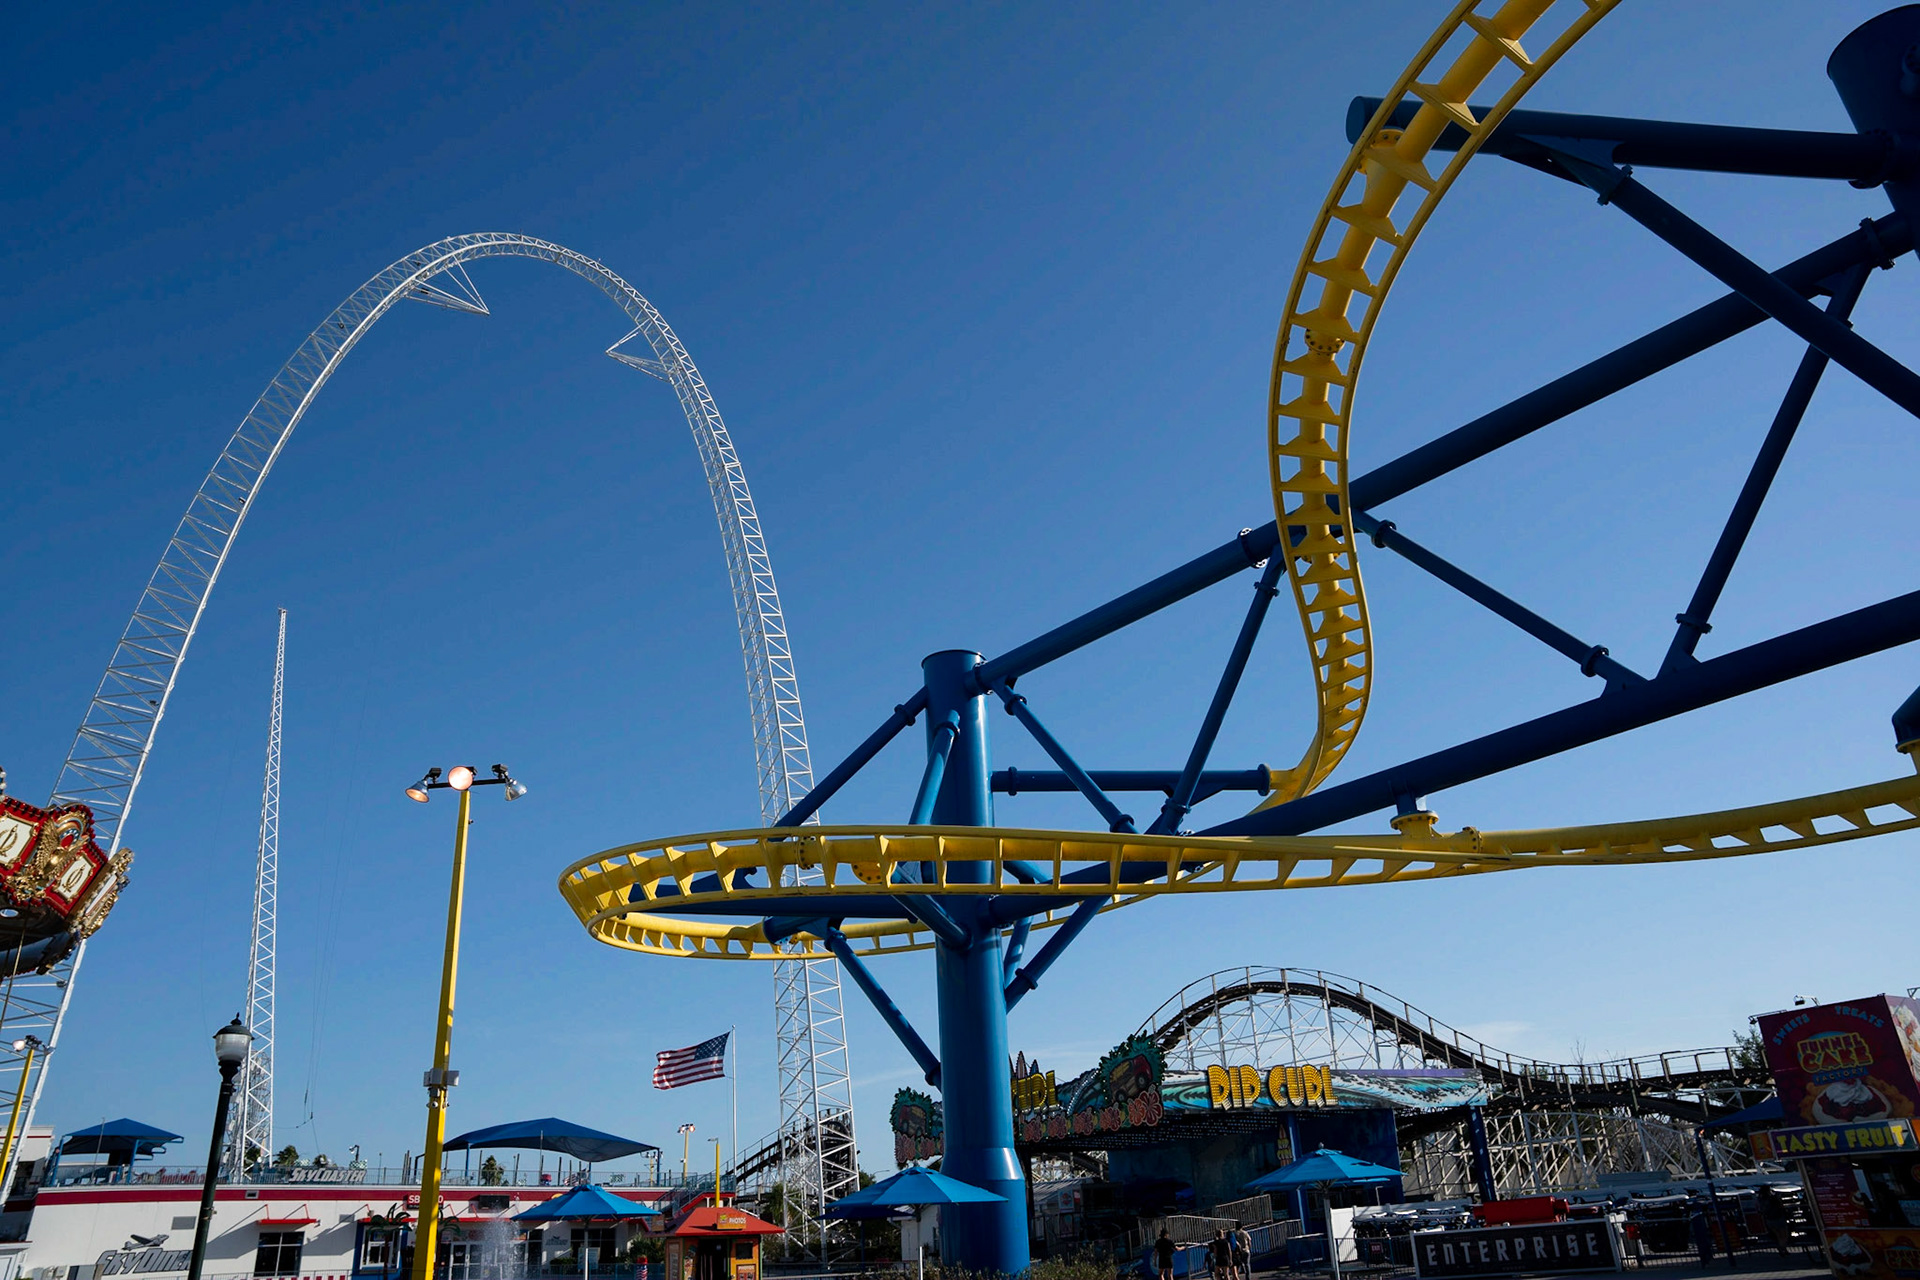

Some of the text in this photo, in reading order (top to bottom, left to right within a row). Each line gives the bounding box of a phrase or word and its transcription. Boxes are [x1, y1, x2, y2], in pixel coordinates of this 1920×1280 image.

[1772, 1005, 1885, 1046] SWEETS TREATS
[1800, 1033, 1863, 1055] FUNNEL
[1801, 1046, 1872, 1072] CAKE
[1207, 1064, 1338, 1110] RIP CURL
[1815, 1067, 1865, 1083] FACTORY
[1776, 1125, 1904, 1152] TASTY FRUIT
[1425, 1232, 1600, 1266] ENTERPRISE
